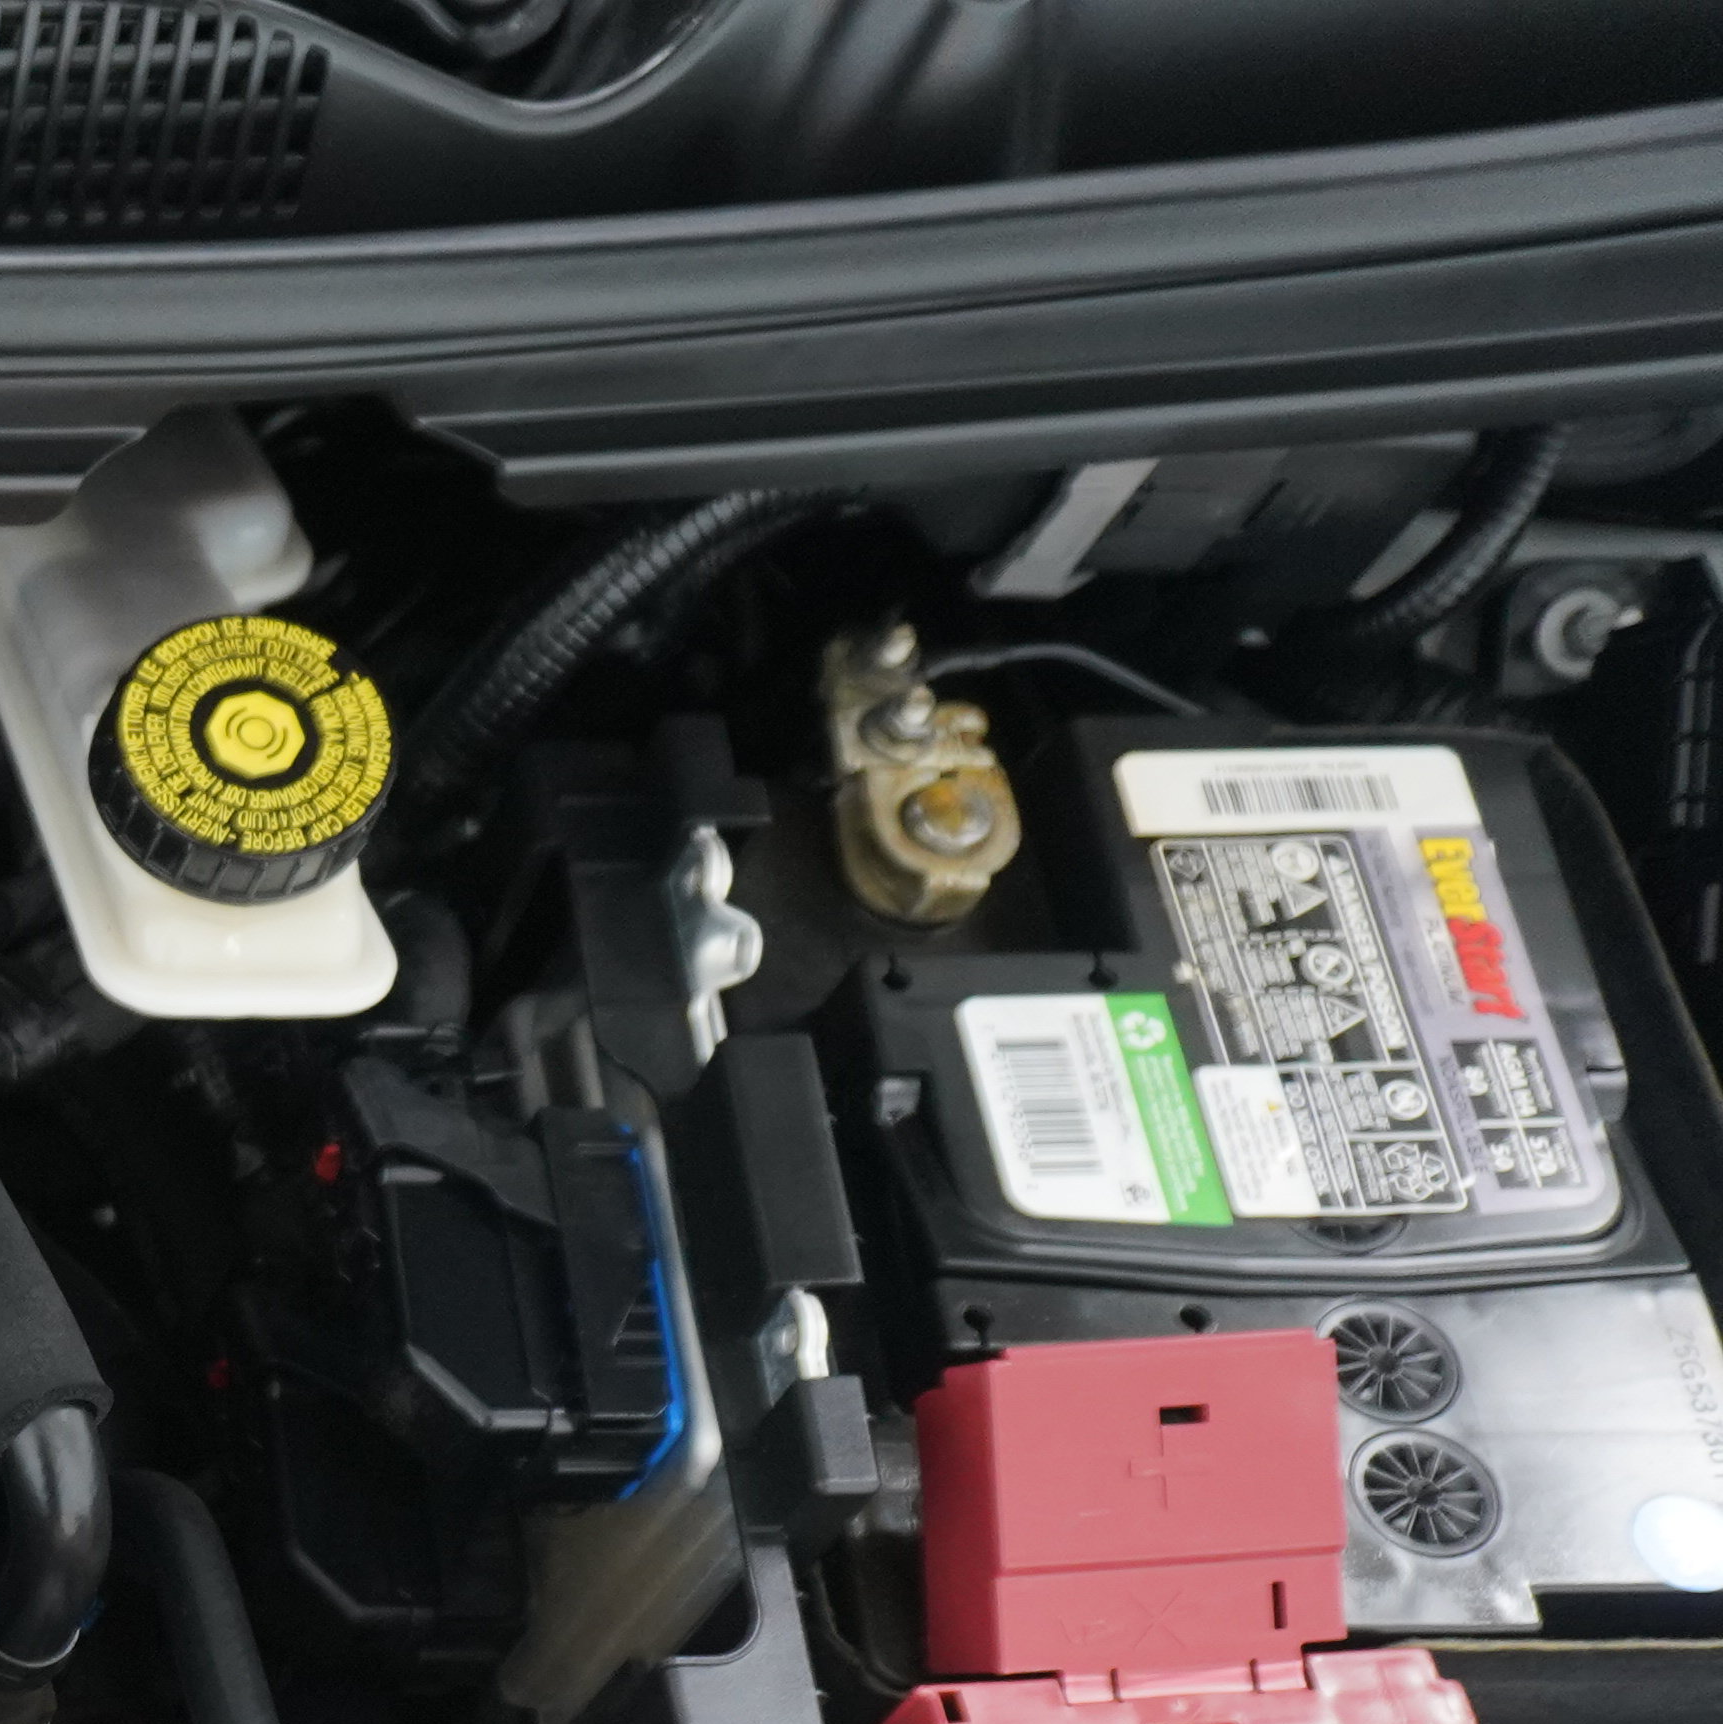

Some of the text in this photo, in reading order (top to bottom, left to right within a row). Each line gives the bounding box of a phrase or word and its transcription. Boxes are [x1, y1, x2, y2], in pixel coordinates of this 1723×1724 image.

[221, 617, 243, 636] DE
[333, 760, 364, 793] USE
[183, 788, 234, 825] AVANT
[236, 809, 279, 830] FLUID
[287, 802, 317, 826] DOT
[241, 828, 308, 852] BEFORE
[309, 812, 346, 842] CAP
[1419, 836, 1528, 1019] EverStart
[1488, 1142, 1516, 1173] 50
[1527, 1136, 1559, 1178] 570
